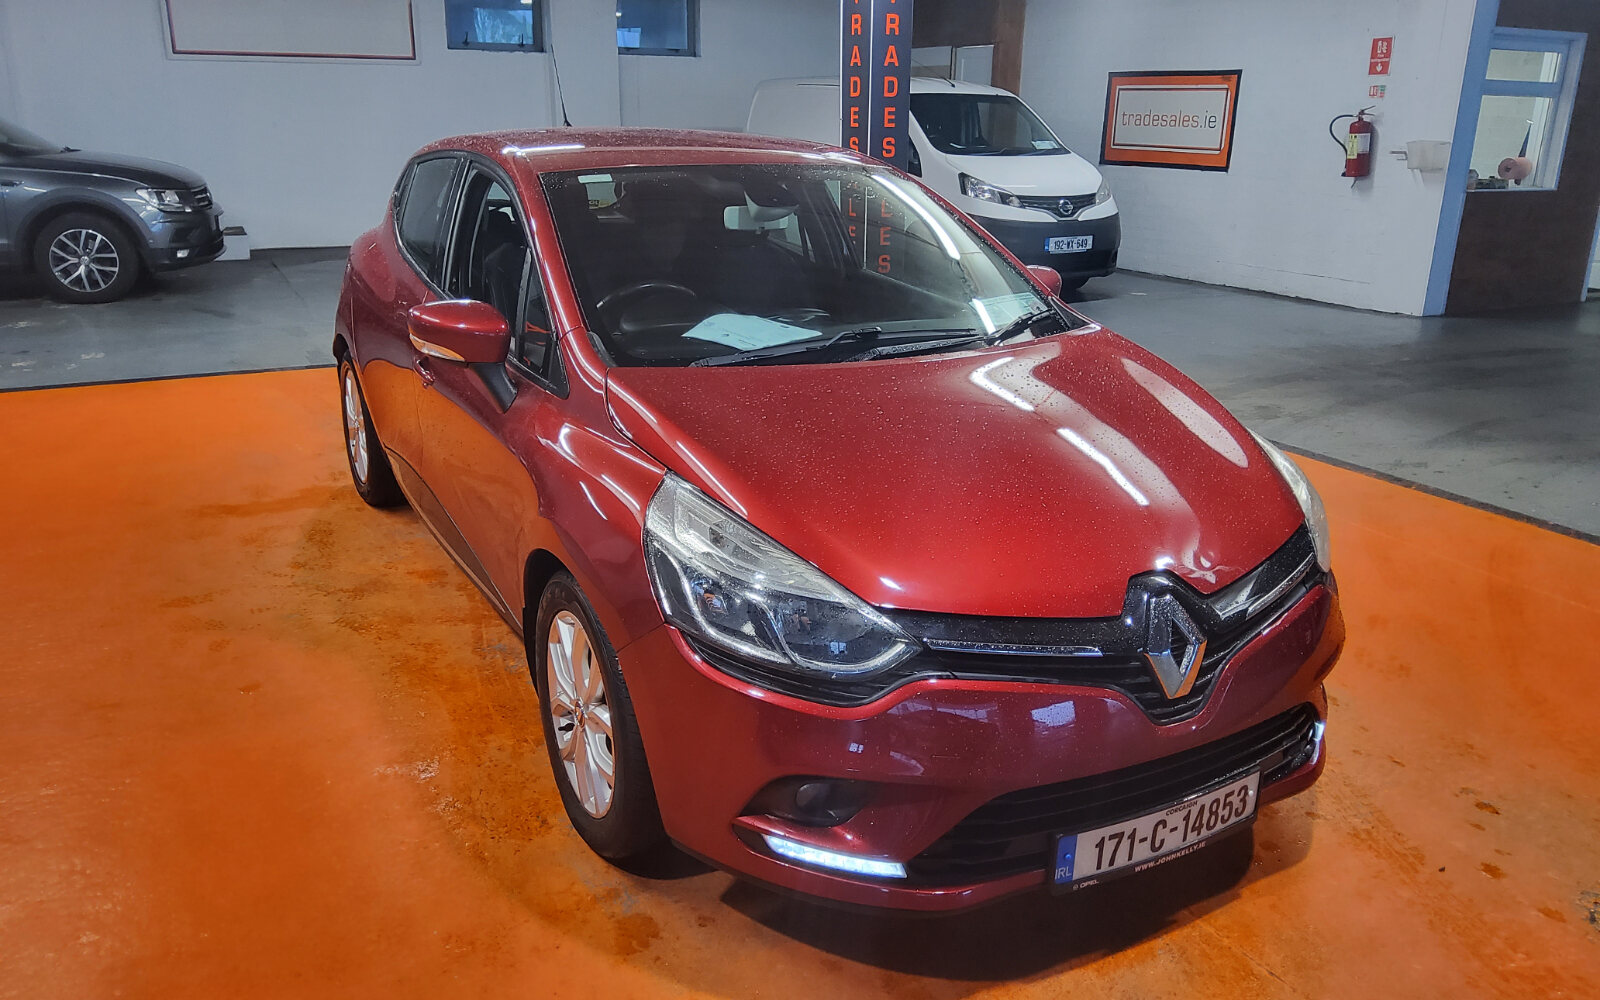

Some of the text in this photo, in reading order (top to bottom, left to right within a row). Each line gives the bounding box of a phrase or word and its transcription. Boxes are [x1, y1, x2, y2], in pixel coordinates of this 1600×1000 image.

[882, 0, 900, 158] RADES
[1121, 109, 1217, 129] tradesales.ie
[1094, 784, 1249, 871] 171-C-14853
[1054, 866, 1072, 880] IRL
